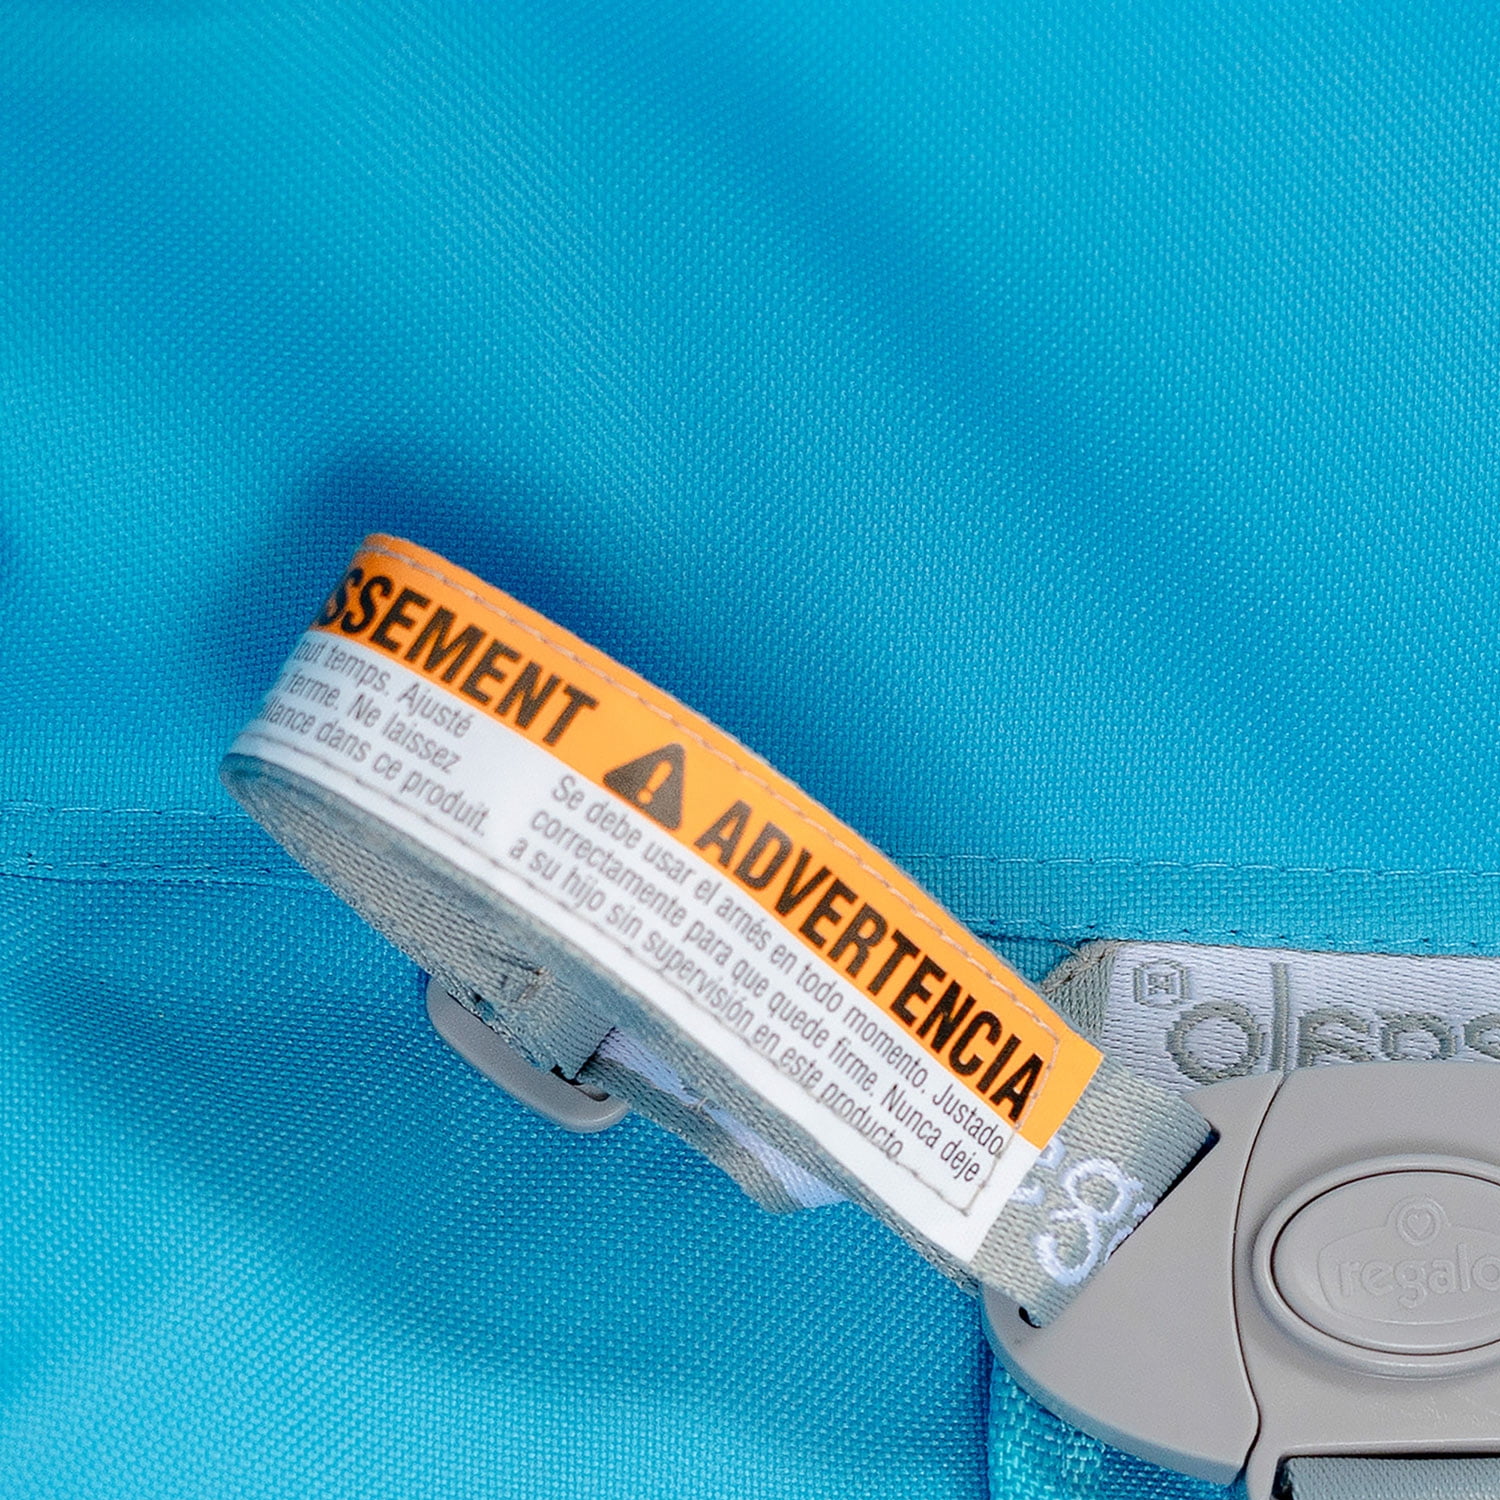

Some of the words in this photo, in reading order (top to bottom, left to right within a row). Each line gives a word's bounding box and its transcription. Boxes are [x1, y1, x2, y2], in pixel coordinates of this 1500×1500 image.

[316, 719, 372, 763] dans
[372, 751, 403, 780] ce
[400, 769, 490, 837] produit.
[323, 643, 391, 697] temps.
[397, 680, 476, 739] Ajusté
[347, 692, 382, 728] Ne
[382, 711, 462, 774] laissez
[508, 837, 529, 861] a
[528, 850, 562, 881] su
[561, 866, 607, 912] hijo
[605, 902, 644, 940] sin
[642, 929, 755, 1034] supervisión
[753, 1023, 781, 1052] en
[779, 1046, 823, 1091] este
[531, 809, 688, 928] correctamente
[682, 919, 734, 966] para
[731, 958, 770, 998] que
[768, 990, 830, 1049] quede
[827, 1036, 879, 1097] firme.
[881, 1082, 943, 1149] Nunca
[940, 1138, 982, 1183] deje
[552, 774, 586, 811] Se
[586, 800, 643, 849] debe
[643, 841, 697, 885] usar
[694, 878, 723, 906] el
[716, 897, 773, 951] arnés
[770, 943, 798, 975] en
[796, 962, 845, 1014] todo
[843, 1005, 929, 1095] momento.
[932, 1082, 1005, 1157] Justado
[693, 799, 1045, 1124] ADVERTENCIA
